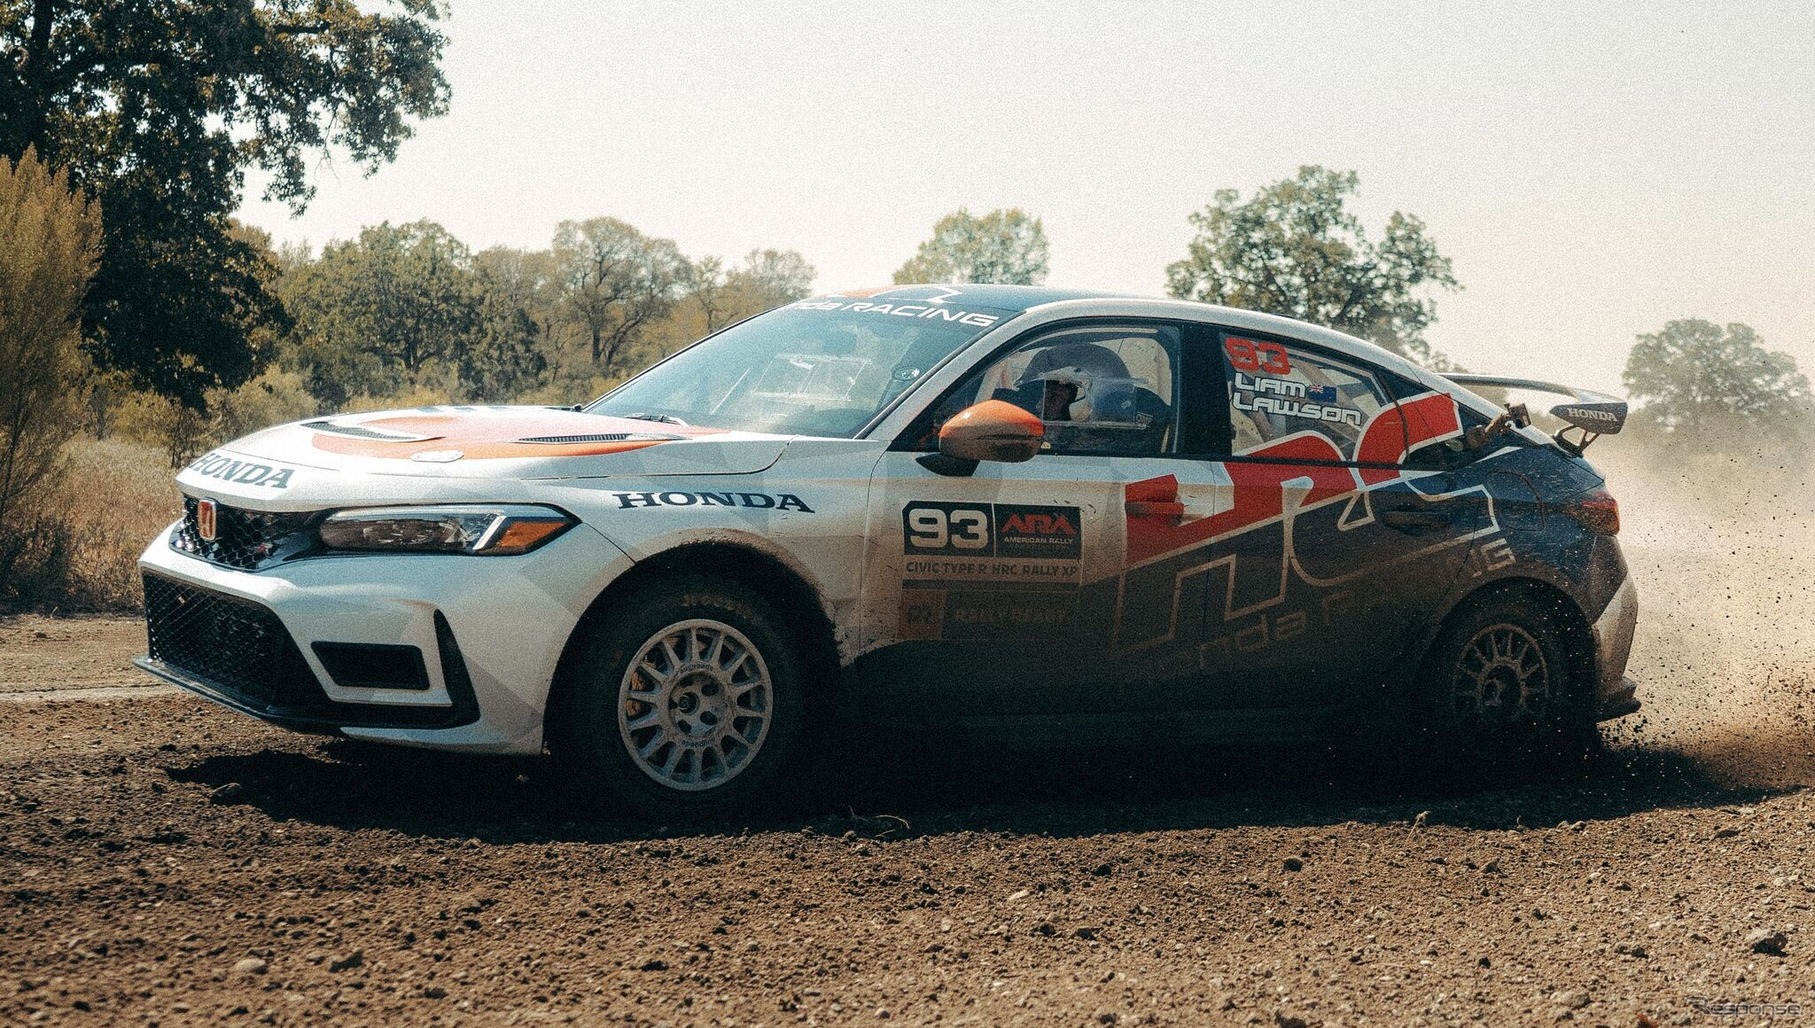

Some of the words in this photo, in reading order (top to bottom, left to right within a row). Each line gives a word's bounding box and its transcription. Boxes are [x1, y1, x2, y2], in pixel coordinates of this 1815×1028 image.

[842, 302, 1000, 327] RACING
[1225, 336, 1291, 375] 93
[1234, 372, 1306, 398] LIAM
[1232, 392, 1362, 426] LAWSON
[1567, 407, 1618, 422] HONDA
[187, 452, 296, 489] HONDA
[612, 491, 816, 514] HONDA
[908, 508, 989, 549] 93
[1001, 513, 1077, 536] ARA
[1004, 536, 1047, 544] AMERICAN
[1048, 537, 1074, 545] RALLY
[906, 561, 941, 574] CIVIC
[941, 562, 977, 575] TYPE
[978, 563, 987, 575] R
[992, 564, 1019, 576] HRC
[1022, 564, 1059, 577] RALLY
[1061, 565, 1078, 577] XP
